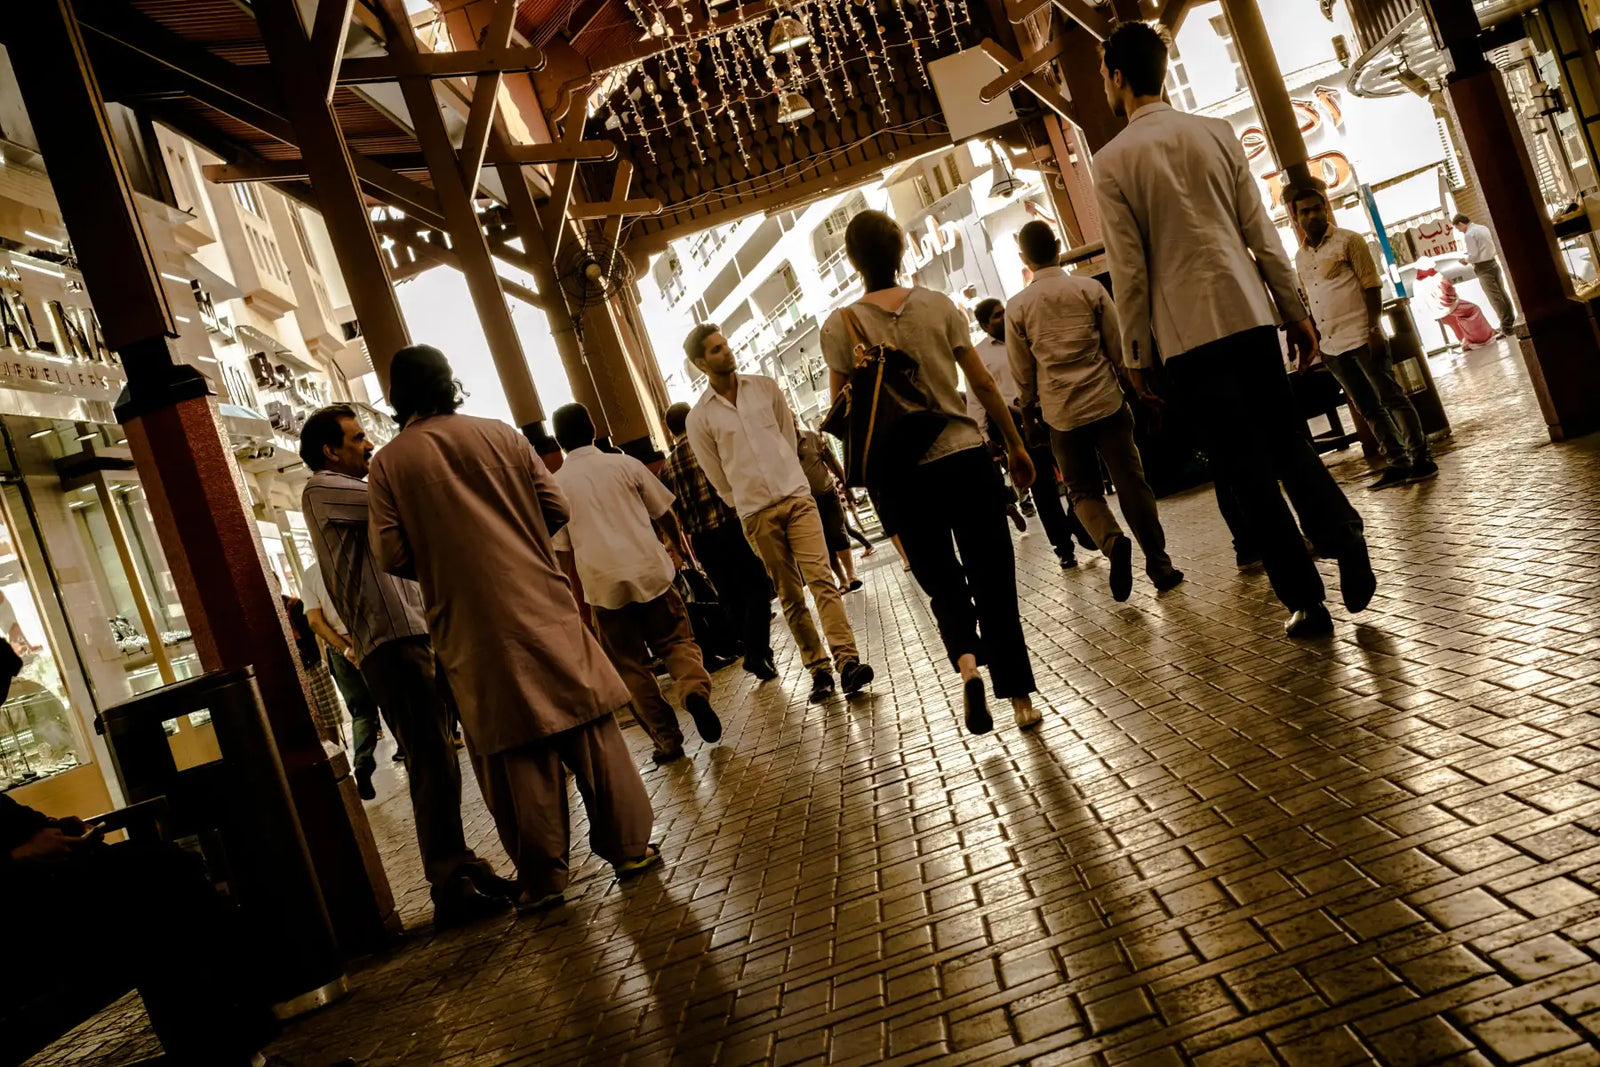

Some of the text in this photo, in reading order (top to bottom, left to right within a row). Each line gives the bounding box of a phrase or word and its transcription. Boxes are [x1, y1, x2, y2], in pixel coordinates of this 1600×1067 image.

[1418, 222, 1453, 242] وليد
[1433, 239, 1464, 256] WAEED
[4, 361, 110, 391] JEWELLERS
